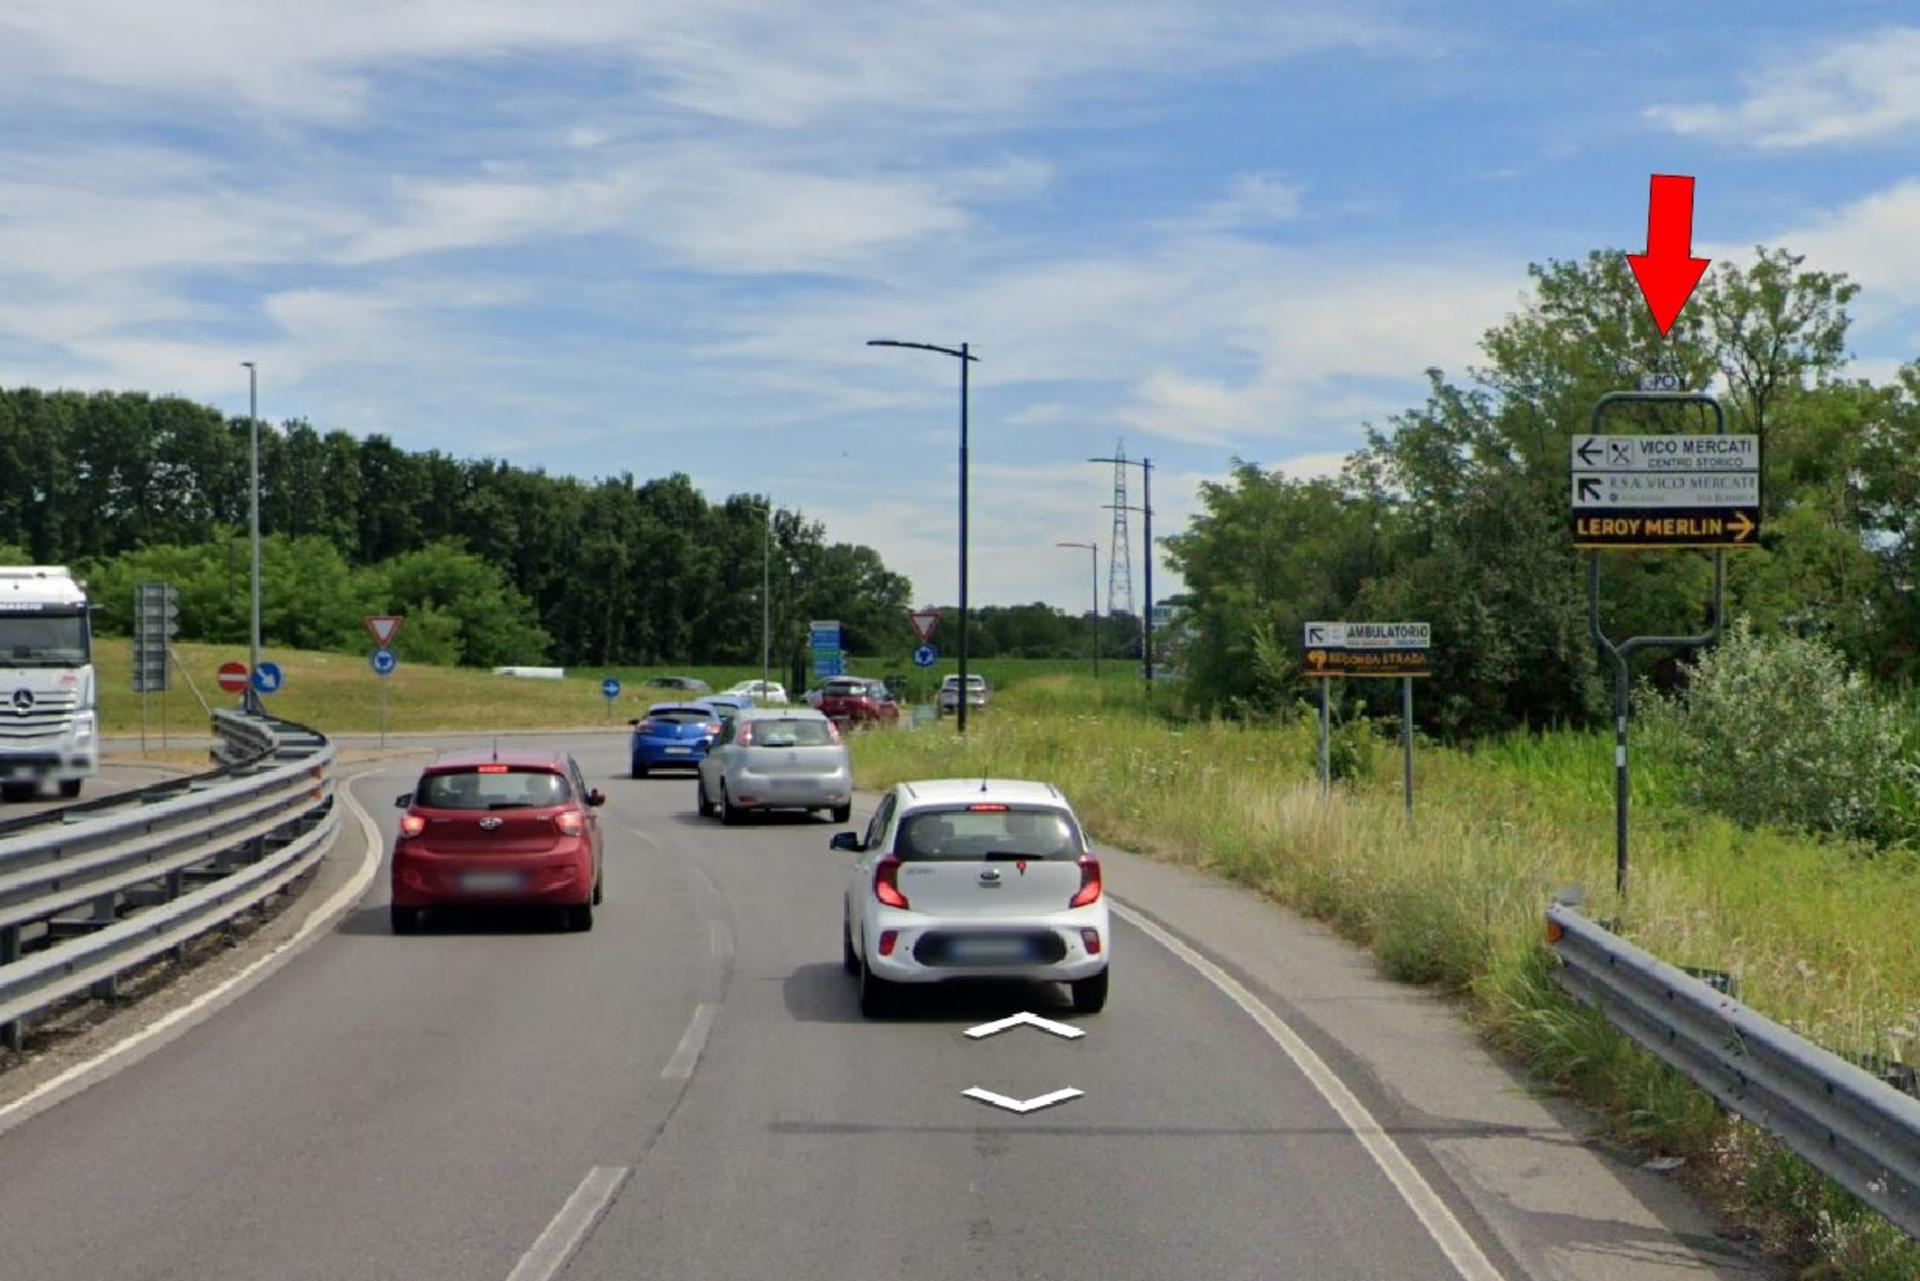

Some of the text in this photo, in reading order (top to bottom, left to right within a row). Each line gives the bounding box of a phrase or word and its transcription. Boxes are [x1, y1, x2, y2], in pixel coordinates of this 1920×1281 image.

[1640, 440, 1752, 454] VICO MERCATI
[1647, 456, 1743, 468] CENTRO STORICO
[1646, 476, 1686, 490] VICO
[1690, 476, 1756, 490] MERCATI
[1577, 519, 1722, 536] LEROY MERLIN
[1347, 625, 1429, 639] AMBULATORIO
